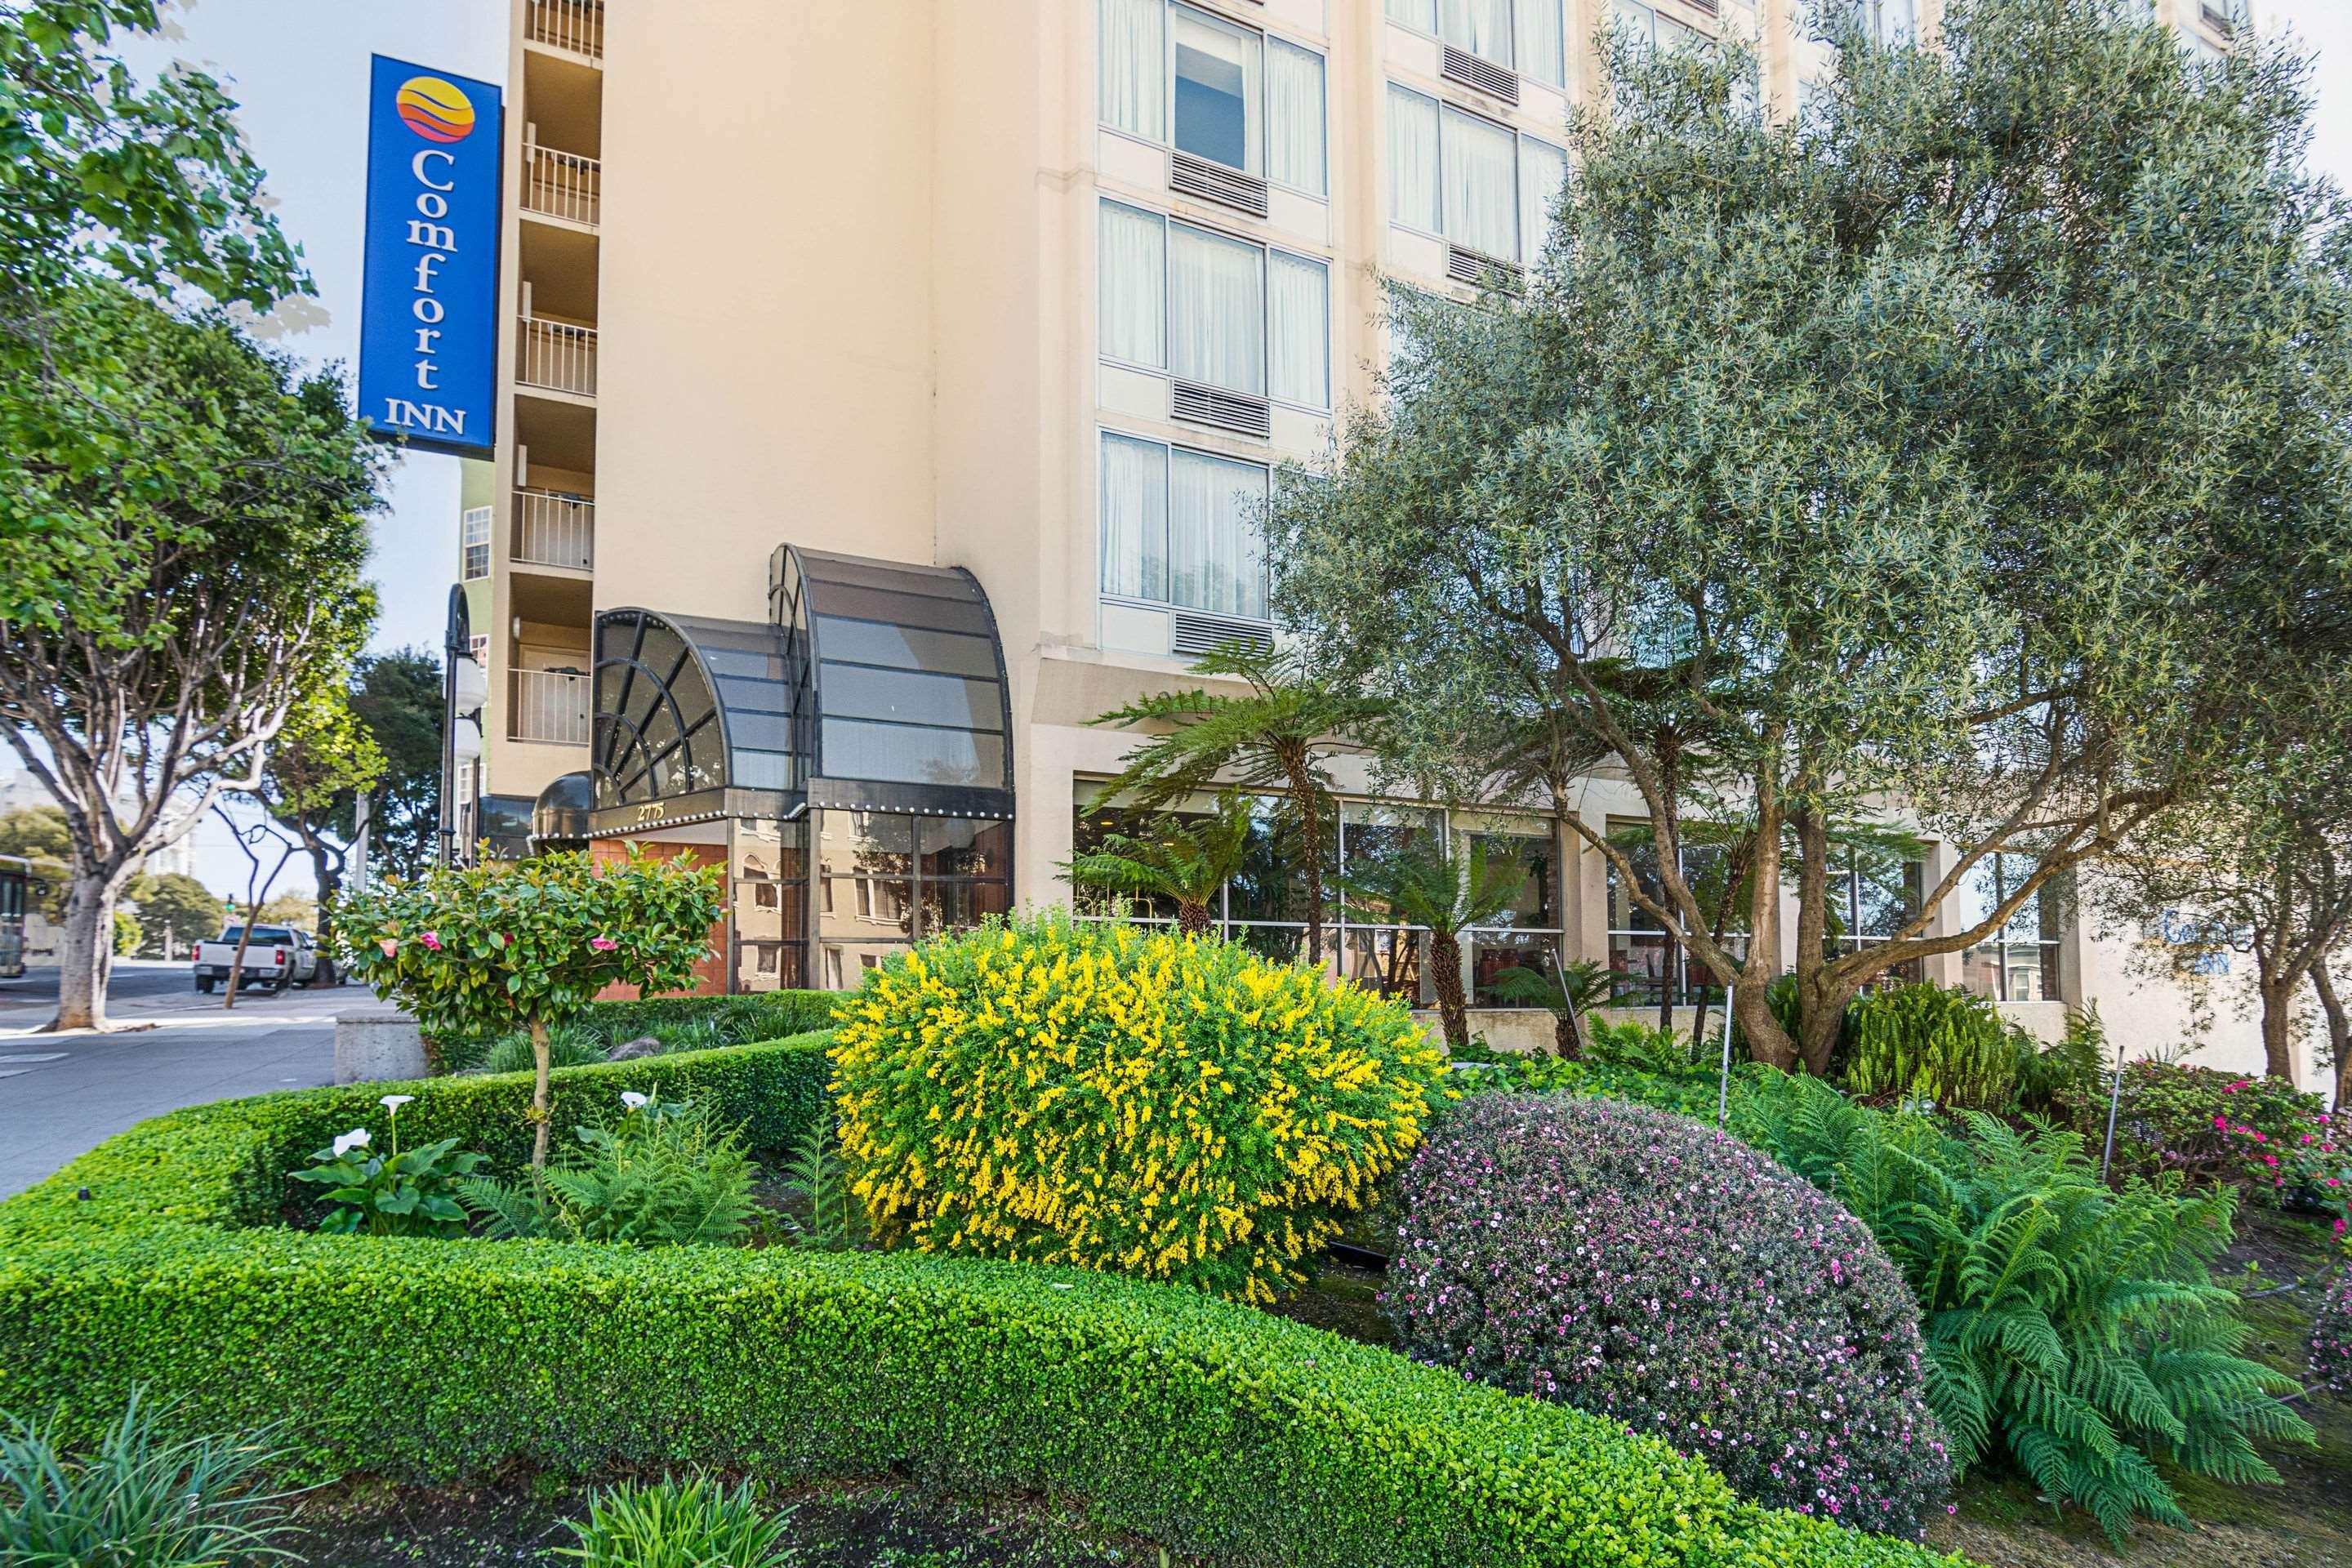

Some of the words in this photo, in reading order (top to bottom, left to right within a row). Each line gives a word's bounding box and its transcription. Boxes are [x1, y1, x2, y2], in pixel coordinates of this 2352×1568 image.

[406, 149, 458, 390] Comfort
[385, 398, 466, 435] INN
[637, 802, 665, 822] 2775
